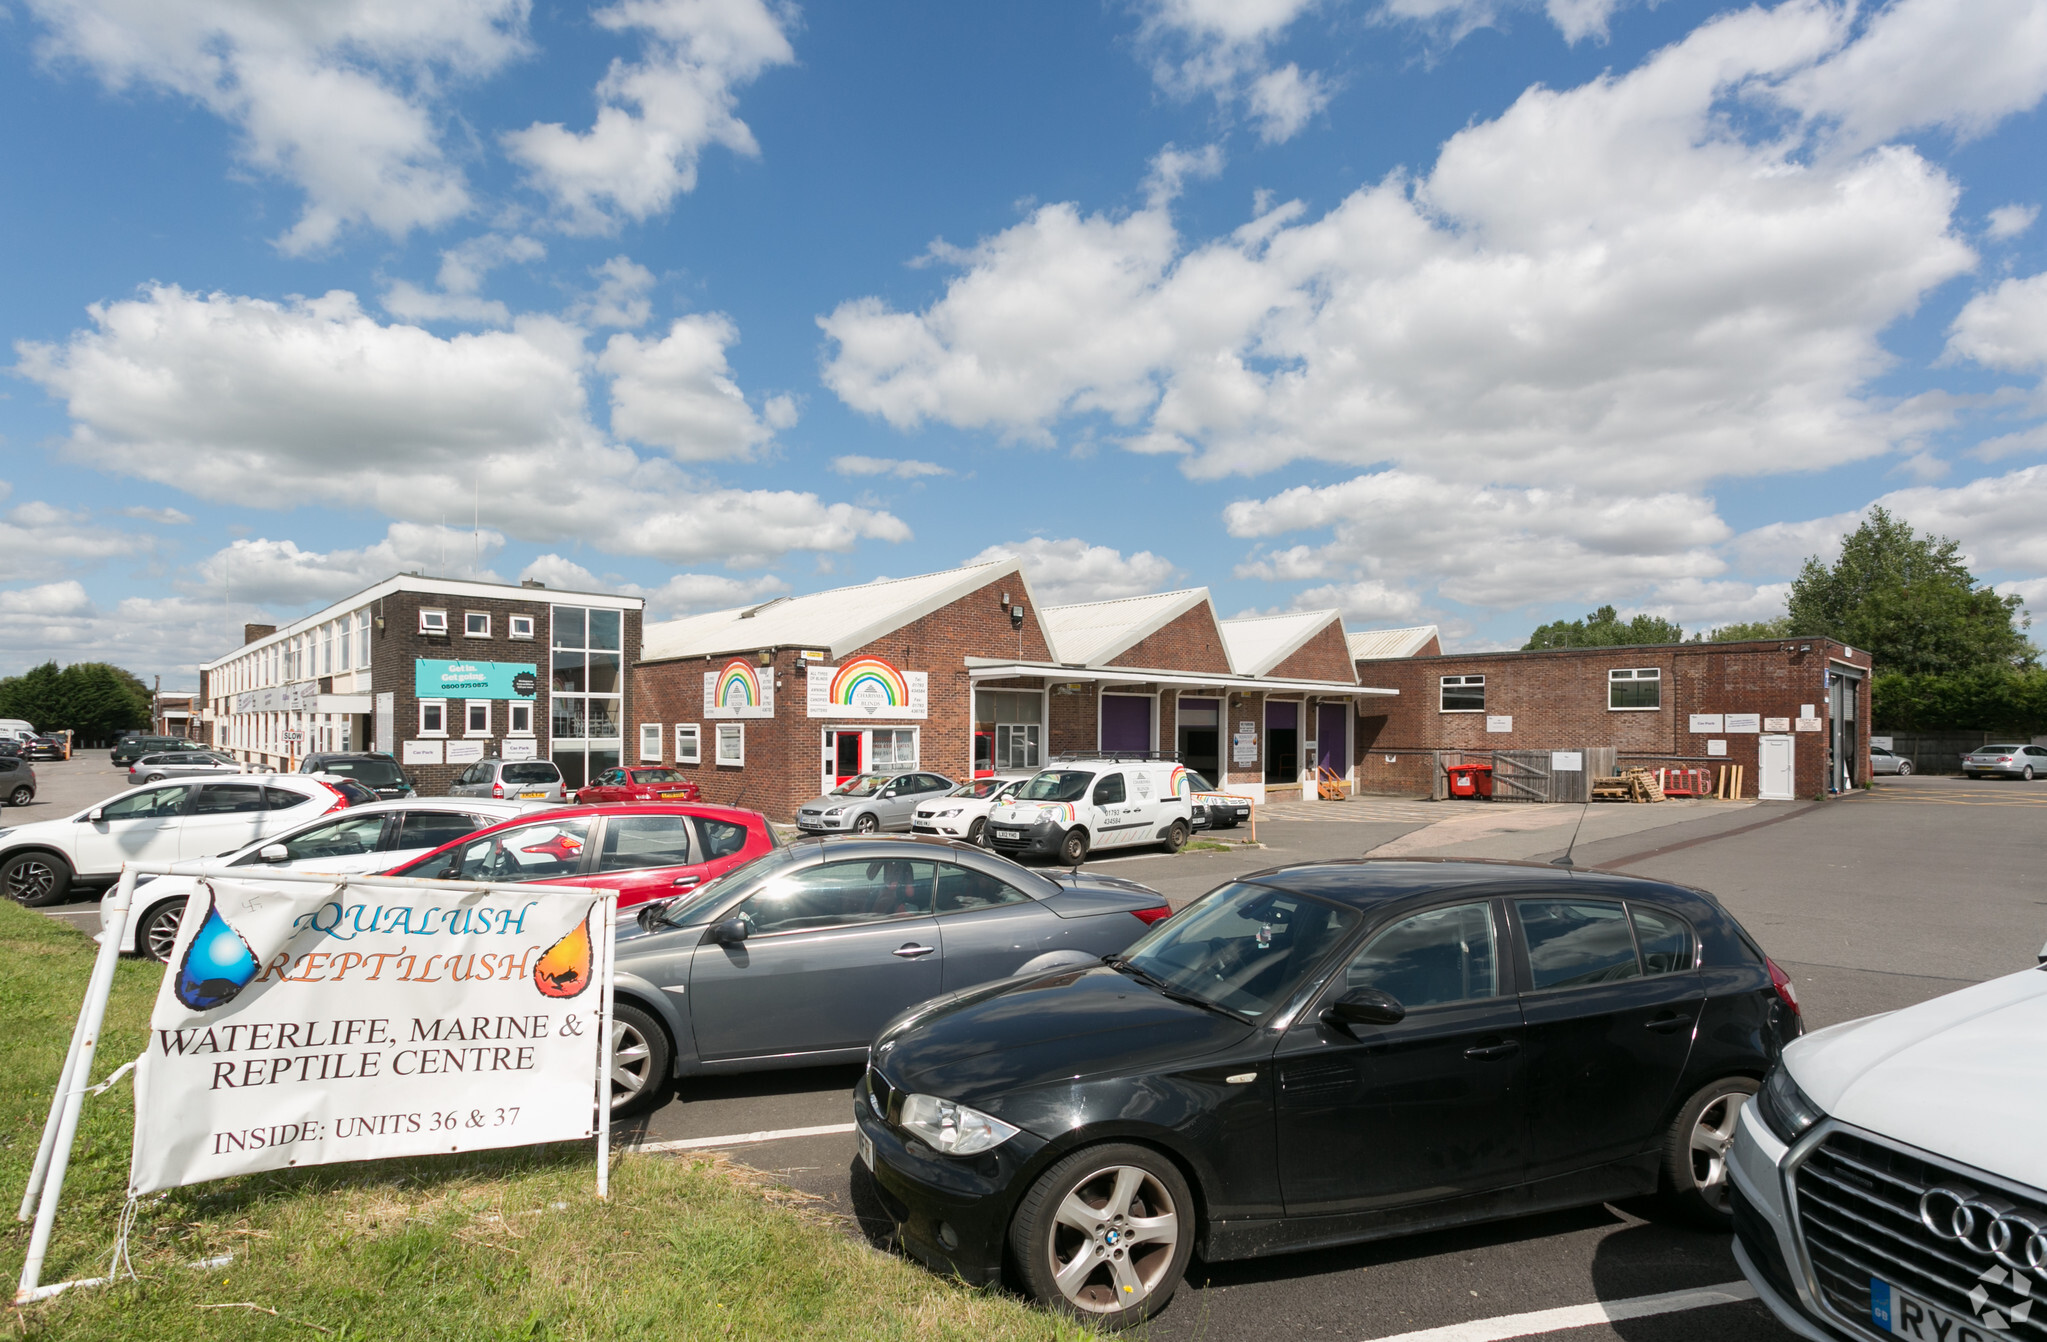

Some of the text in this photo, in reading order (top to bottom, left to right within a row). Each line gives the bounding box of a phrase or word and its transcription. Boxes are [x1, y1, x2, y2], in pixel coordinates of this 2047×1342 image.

[448, 664, 463, 672] Get
[441, 673, 486, 682] Get going.
[284, 732, 302, 740] SLOW
[1105, 809, 1120, 817] 01793
[1104, 817, 1121, 825] 434584
[254, 945, 541, 983] REPTILUSH
[157, 1013, 584, 1057] WATERLIFE, MARINE &
[208, 1046, 535, 1090] REPTILE CENTRE
[211, 1107, 521, 1155] INSIDE: UNITS 36 & 37
[1874, 1307, 1888, 1321] GB
